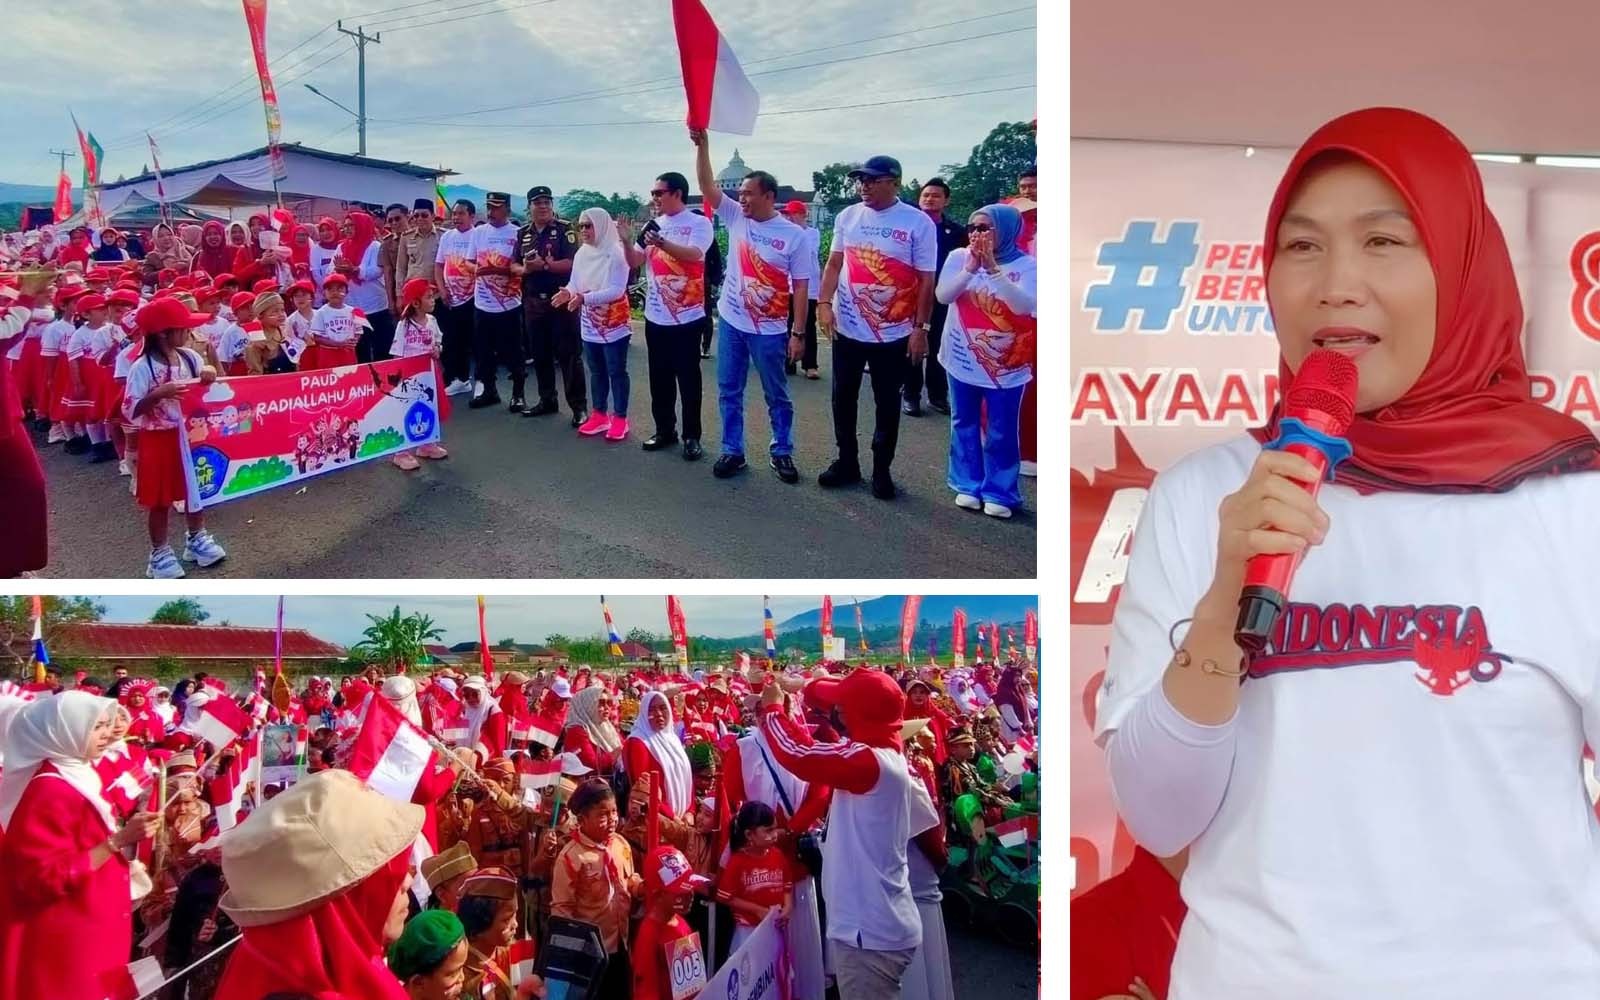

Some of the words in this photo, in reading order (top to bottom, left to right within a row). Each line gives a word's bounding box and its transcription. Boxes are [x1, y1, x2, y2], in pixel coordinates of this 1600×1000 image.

[301, 373, 338, 391] PAUD
[255, 390, 345, 417] RADIALLAHU
[348, 384, 375, 399] ANH
[673, 951, 701, 985] 005
